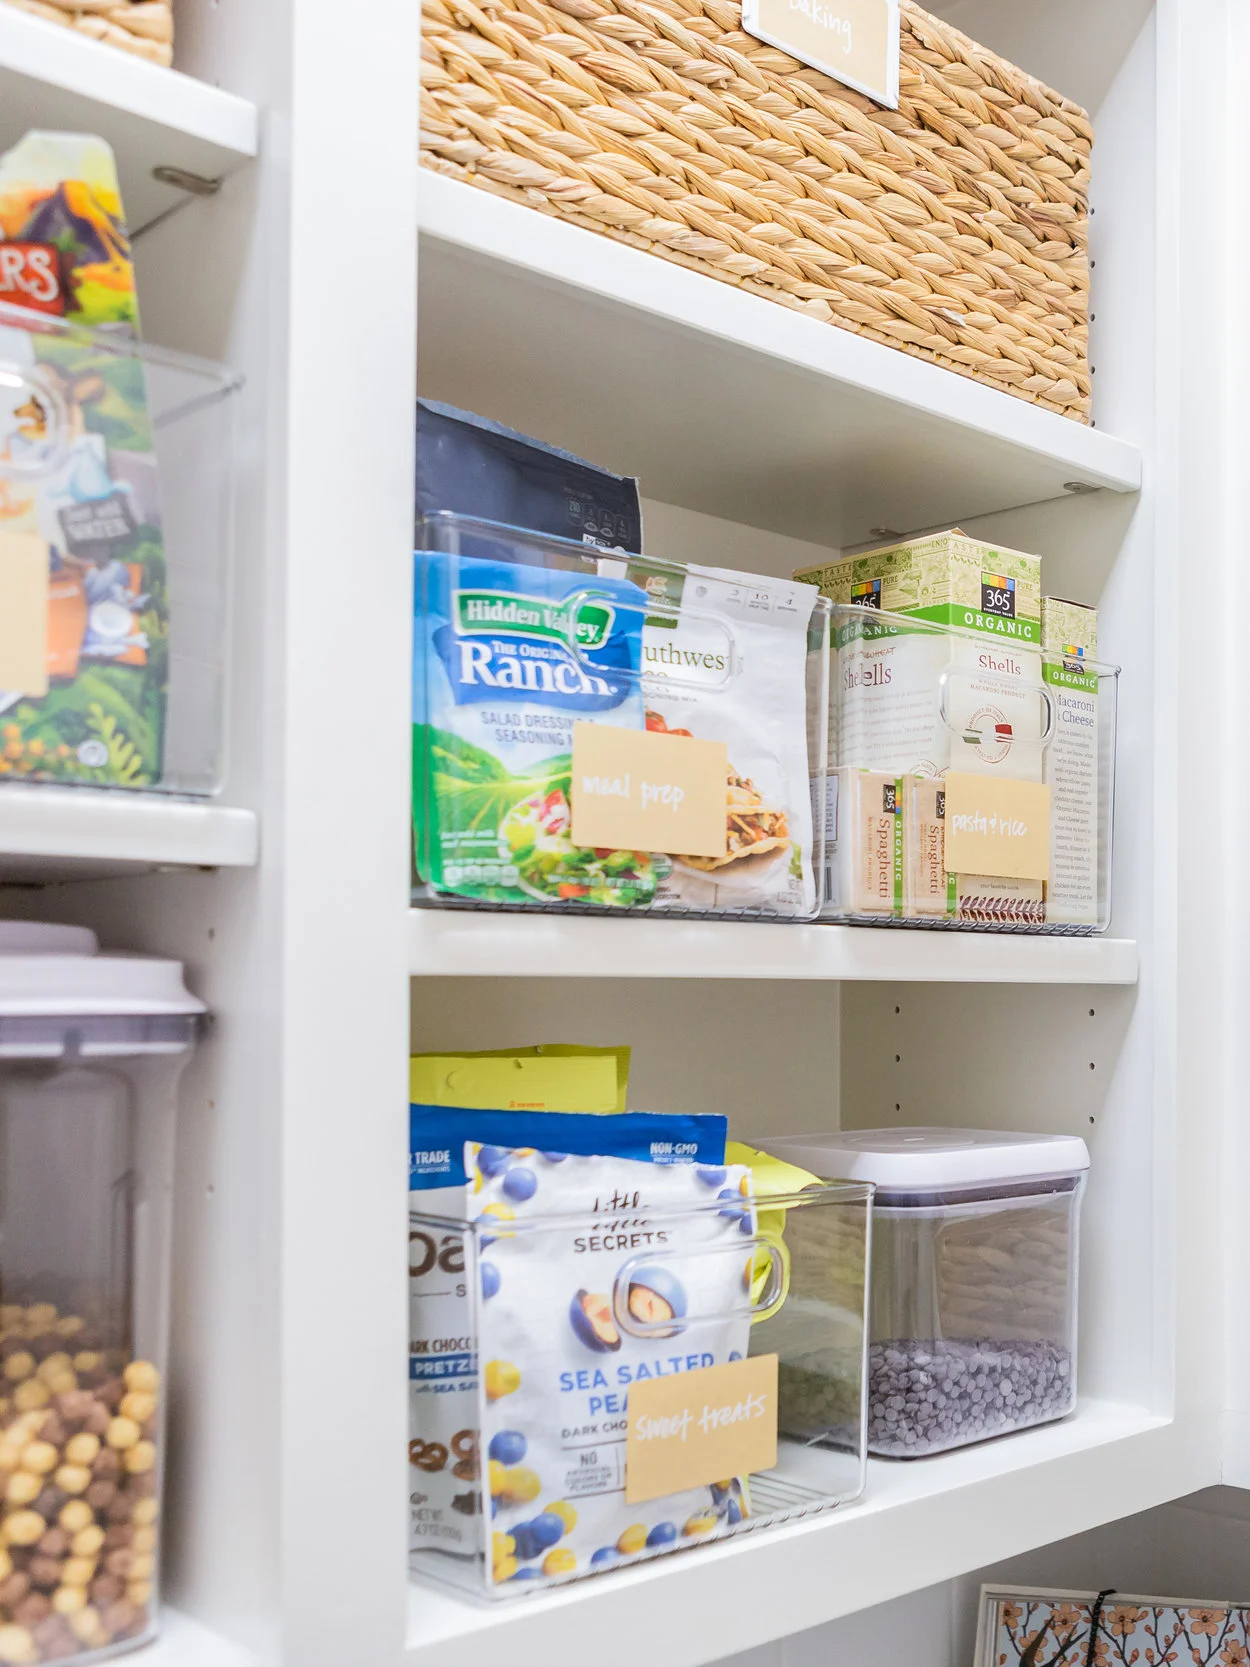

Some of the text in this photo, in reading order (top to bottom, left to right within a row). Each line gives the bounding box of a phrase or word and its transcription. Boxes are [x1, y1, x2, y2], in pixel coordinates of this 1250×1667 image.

[0, 248, 60, 302] RS
[953, 541, 980, 555] ASTE
[986, 589, 1011, 611] 365
[467, 599, 541, 627] Hidden
[963, 612, 1032, 638] ORGANIC
[644, 643, 730, 671] uthwes
[978, 654, 1022, 675] Shells
[1053, 671, 1096, 689] ORGANIC
[481, 711, 583, 730] SALAD DRESSIN
[1062, 710, 1095, 728] Cheese
[495, 728, 565, 746] SEASONING
[582, 772, 685, 813] meal prep
[885, 788, 896, 810] 365
[951, 810, 987, 838] pasta
[999, 816, 1029, 837] rice
[876, 818, 891, 898] Spaghetti
[927, 825, 941, 894] Spaghetti
[415, 1150, 450, 1164] TRADE
[650, 1141, 698, 1155] NON-GMO
[573, 1231, 669, 1253] SECRETS
[559, 1352, 715, 1393] SEA SALTED
[635, 1393, 767, 1442] sweet treats
[561, 1426, 598, 1439] DARK
